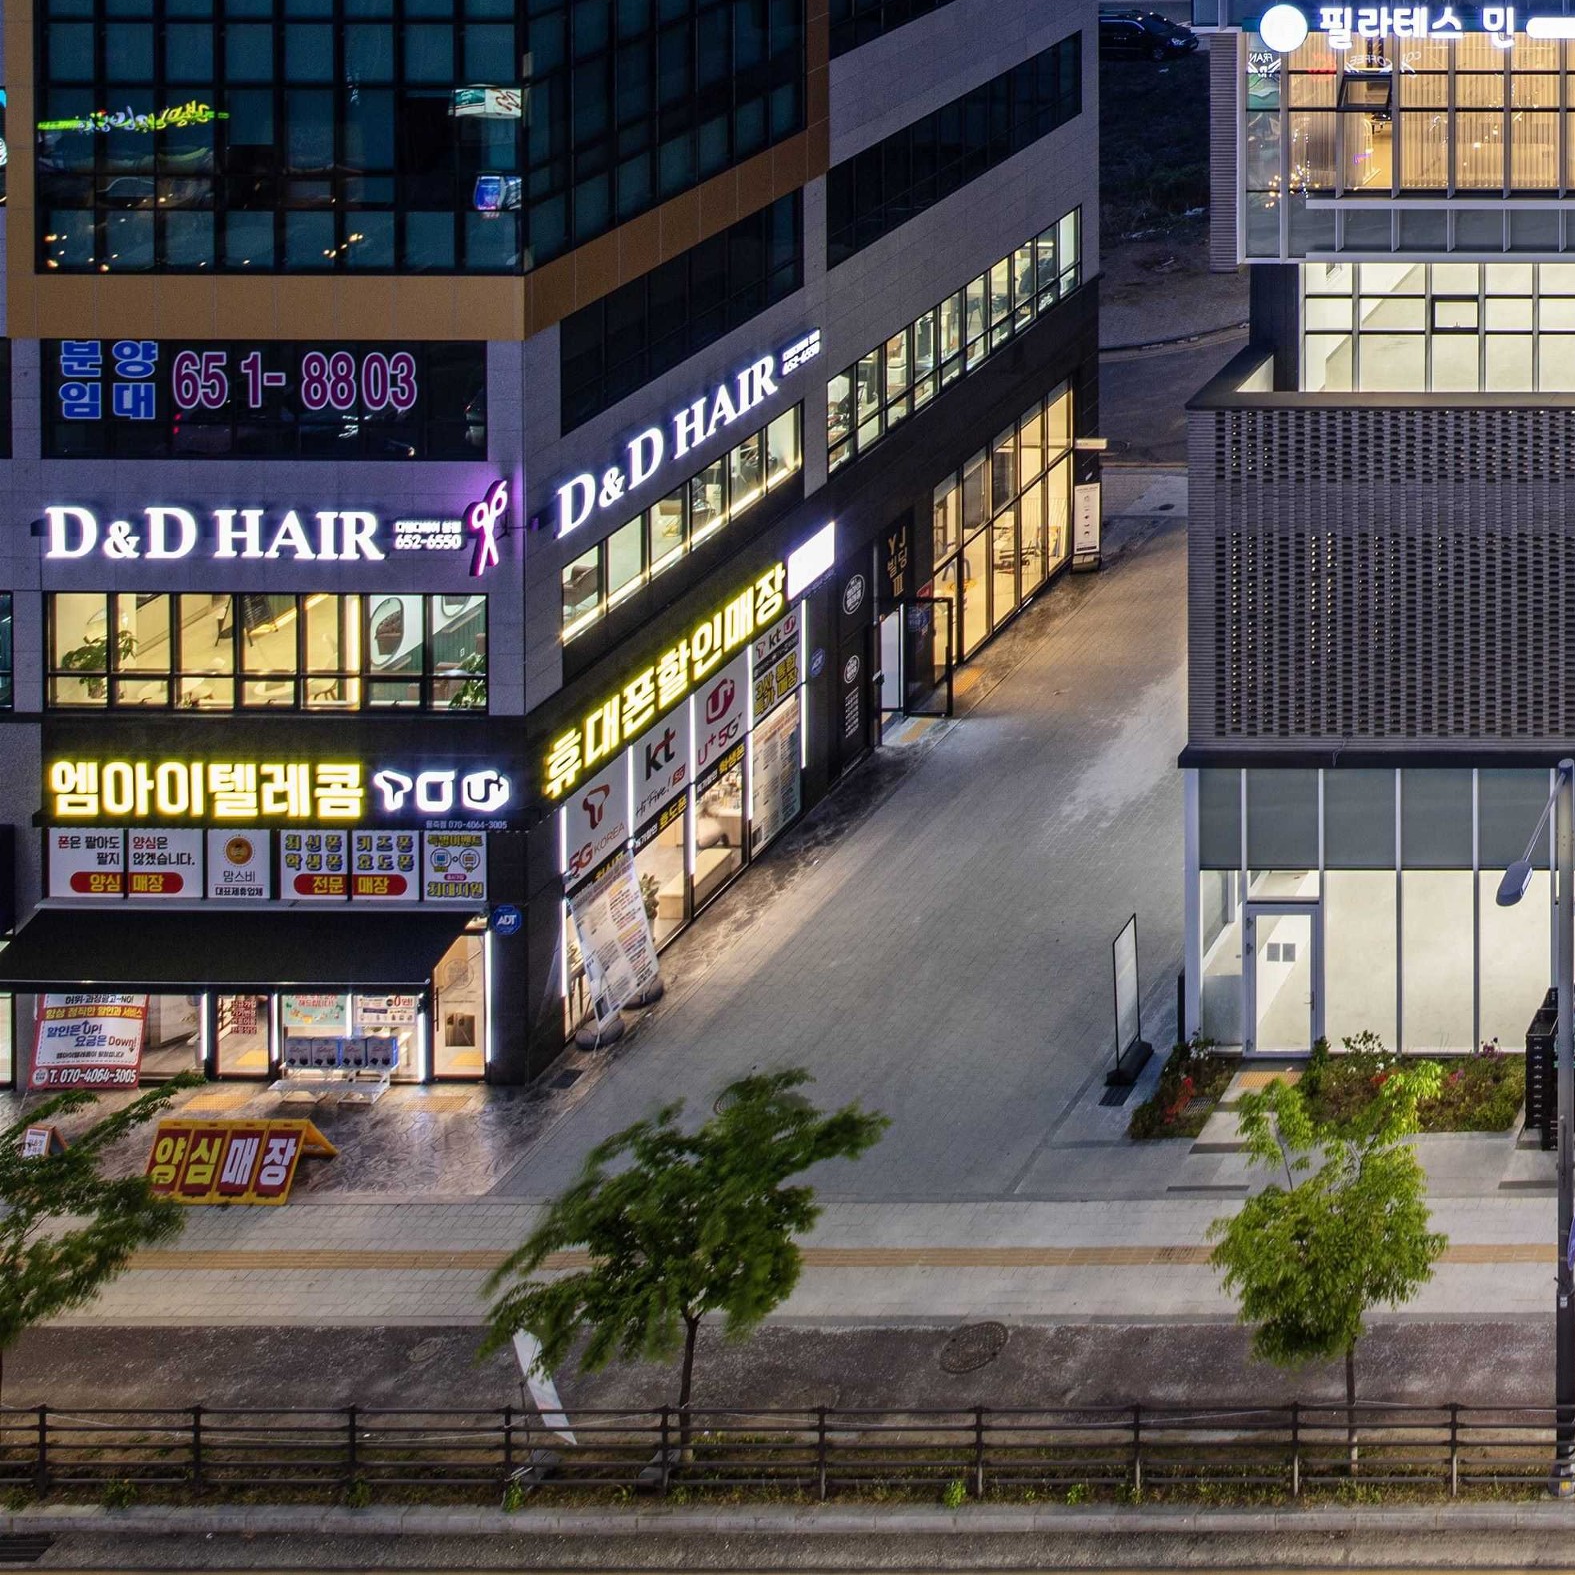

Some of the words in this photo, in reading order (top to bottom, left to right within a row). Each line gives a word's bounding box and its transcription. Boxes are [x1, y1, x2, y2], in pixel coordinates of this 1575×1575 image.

[1319, 6, 1465, 50] 필라테스
[1482, 6, 1515, 49] 민
[59, 340, 158, 379] 분양
[59, 381, 156, 420] 임대
[555, 426, 664, 541] D&D
[670, 354, 778, 459] HAIR
[44, 505, 198, 560] D&D
[213, 508, 386, 562] HAIR
[395, 534, 462, 550] 652-6550
[541, 561, 787, 801] 휴대폰할인매장
[645, 727, 676, 781] kt
[50, 759, 364, 819] 엠아이텔레콤
[448, 820, 508, 830] 070-4064-3005
[85, 836, 120, 849] 팔아도
[132, 836, 168, 849] 양심은
[285, 834, 343, 852] 최신폰
[356, 834, 414, 852] 키즈폰
[568, 848, 593, 879] 5G
[593, 823, 625, 855] KOREA
[97, 853, 120, 866] 팔지
[132, 852, 196, 866] 않겠습니다.
[285, 854, 343, 872] 학생폰
[356, 854, 415, 872] 효도폰
[89, 874, 121, 892] 양심
[132, 874, 164, 892] 매장
[312, 876, 344, 894] 전문
[357, 876, 389, 894] 매장
[497, 913, 517, 927] ADT
[46, 1024, 81, 1038] 할인은
[82, 1023, 103, 1035] UP!
[75, 1036, 107, 1047] 요금은
[108, 1036, 137, 1047] Down!
[49, 1069, 58, 1083] T.
[60, 1068, 137, 1084] 070-4064-3005
